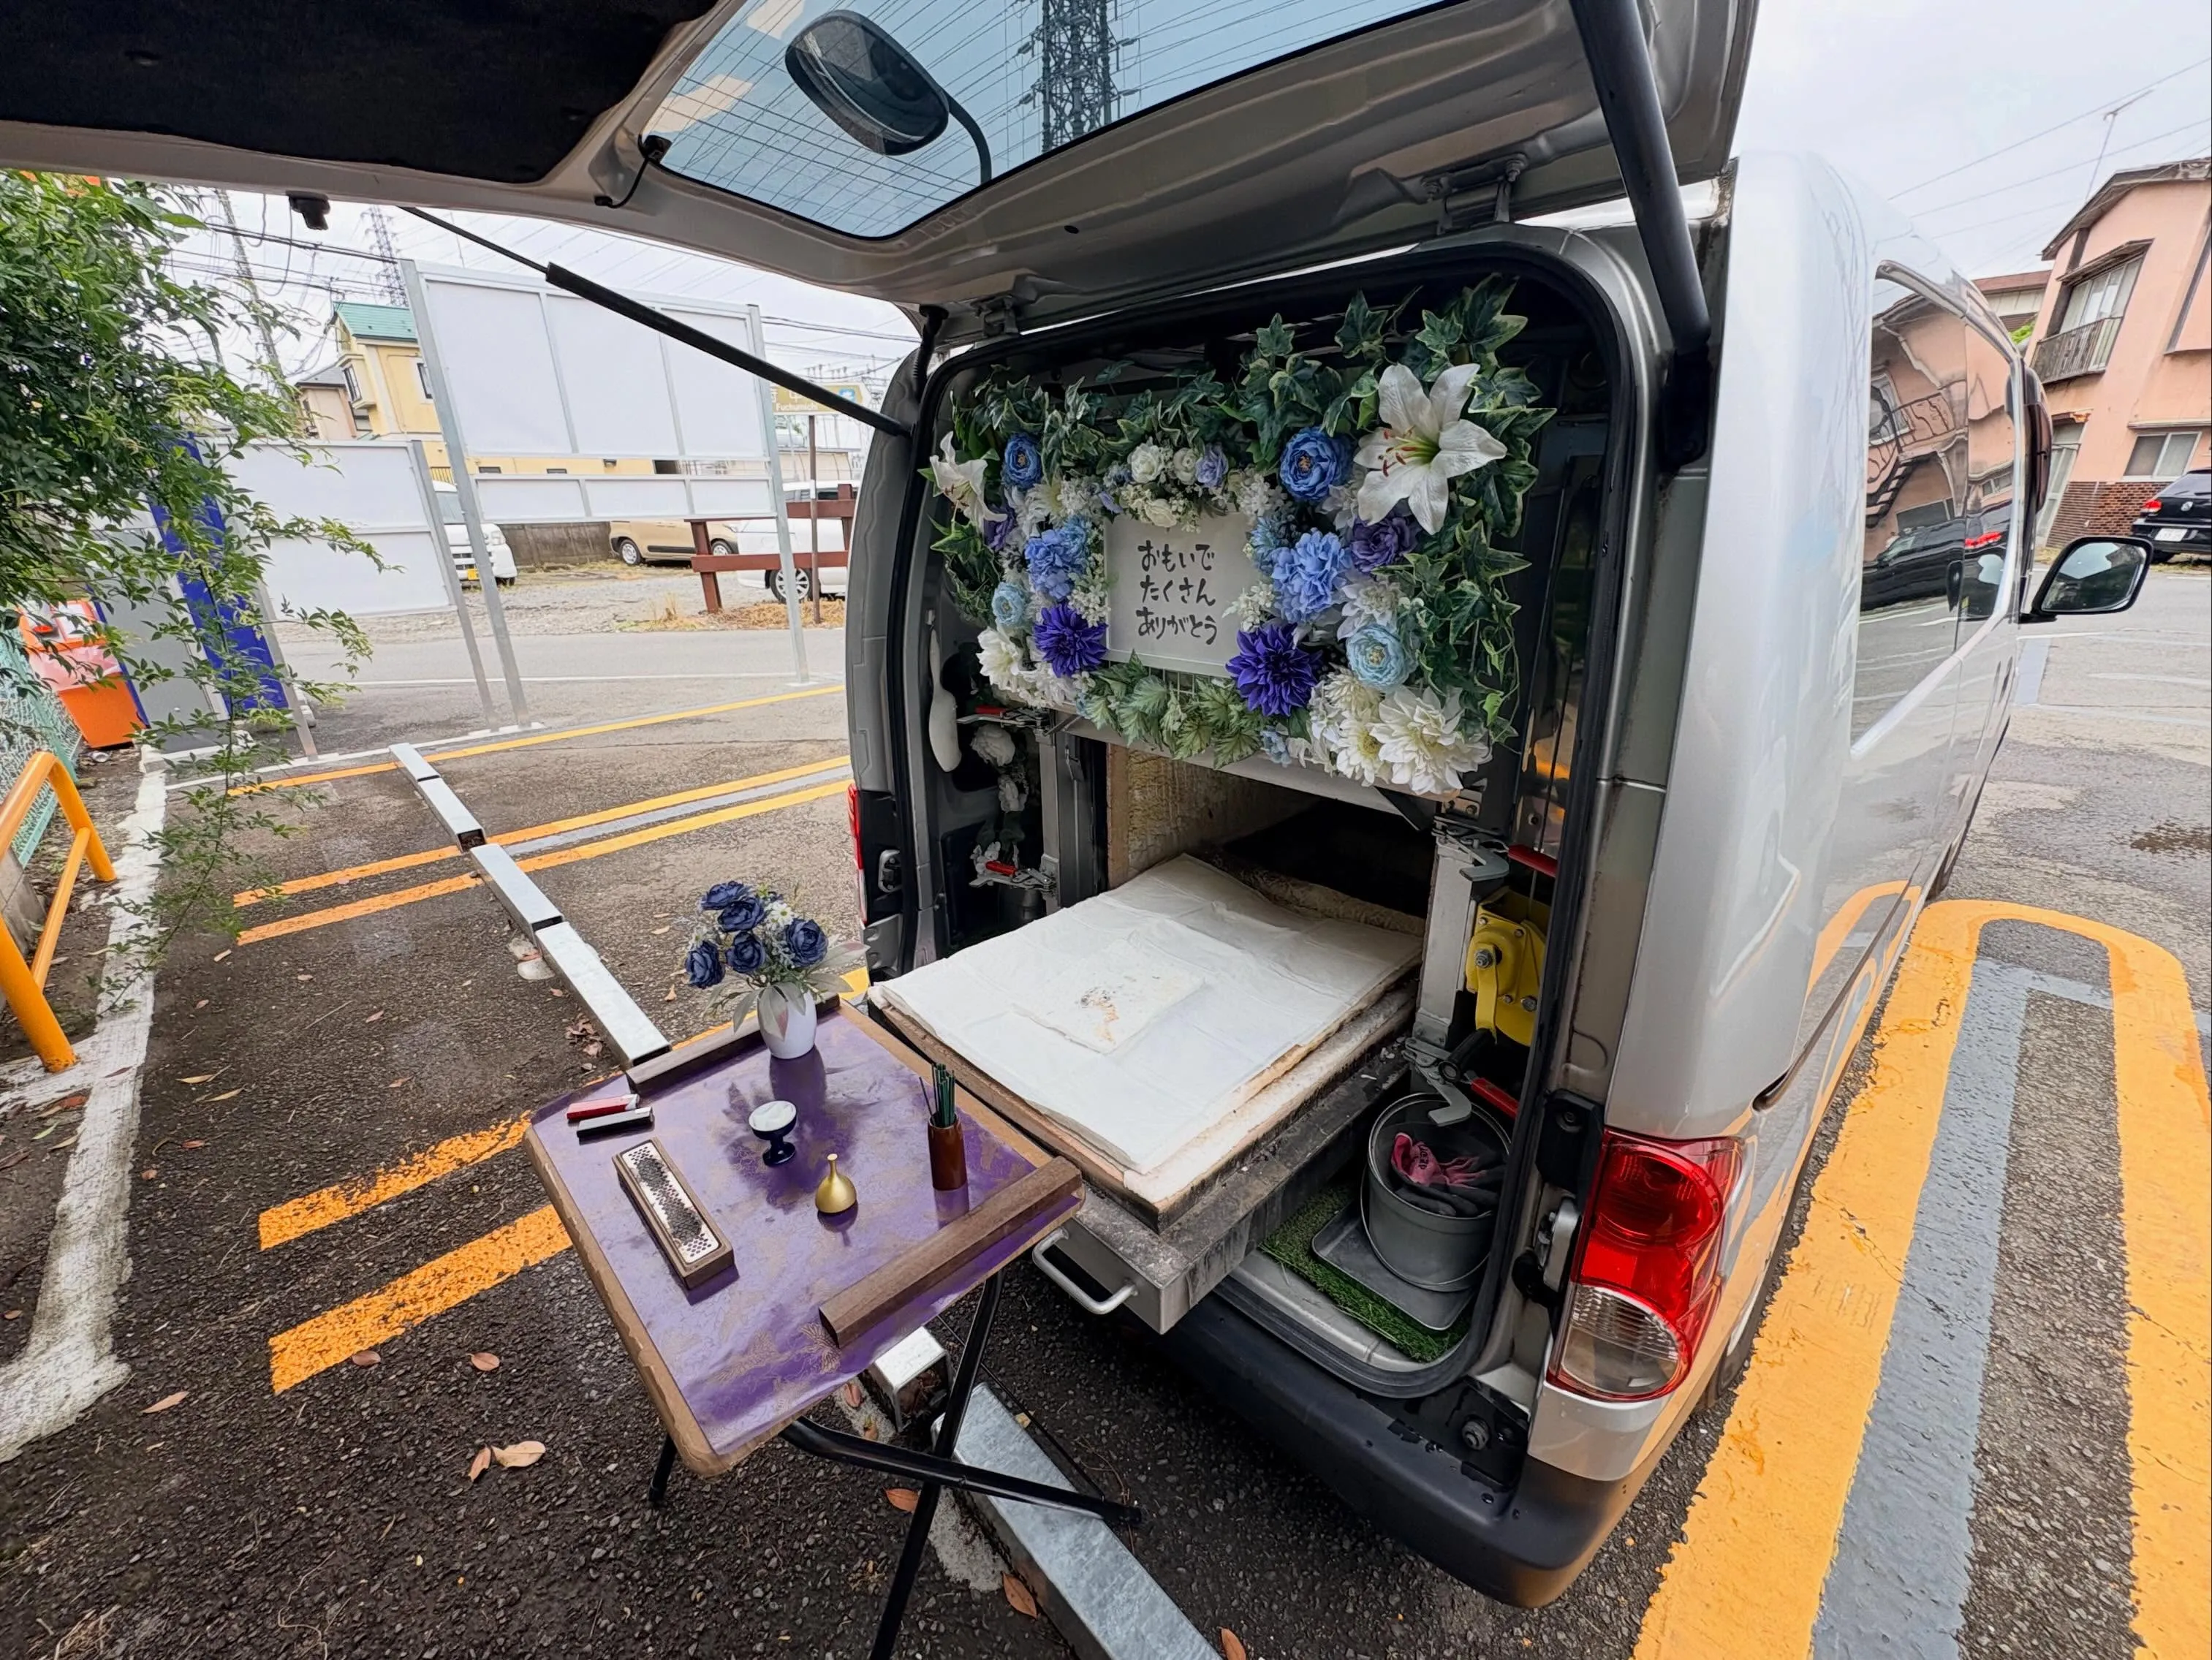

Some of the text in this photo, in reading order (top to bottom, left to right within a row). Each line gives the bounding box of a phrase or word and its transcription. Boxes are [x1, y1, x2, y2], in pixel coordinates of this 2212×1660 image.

[1137, 539, 1215, 572] おもいで
[1140, 575, 1216, 607] たくさん
[1136, 606, 1218, 645] ありがとう
